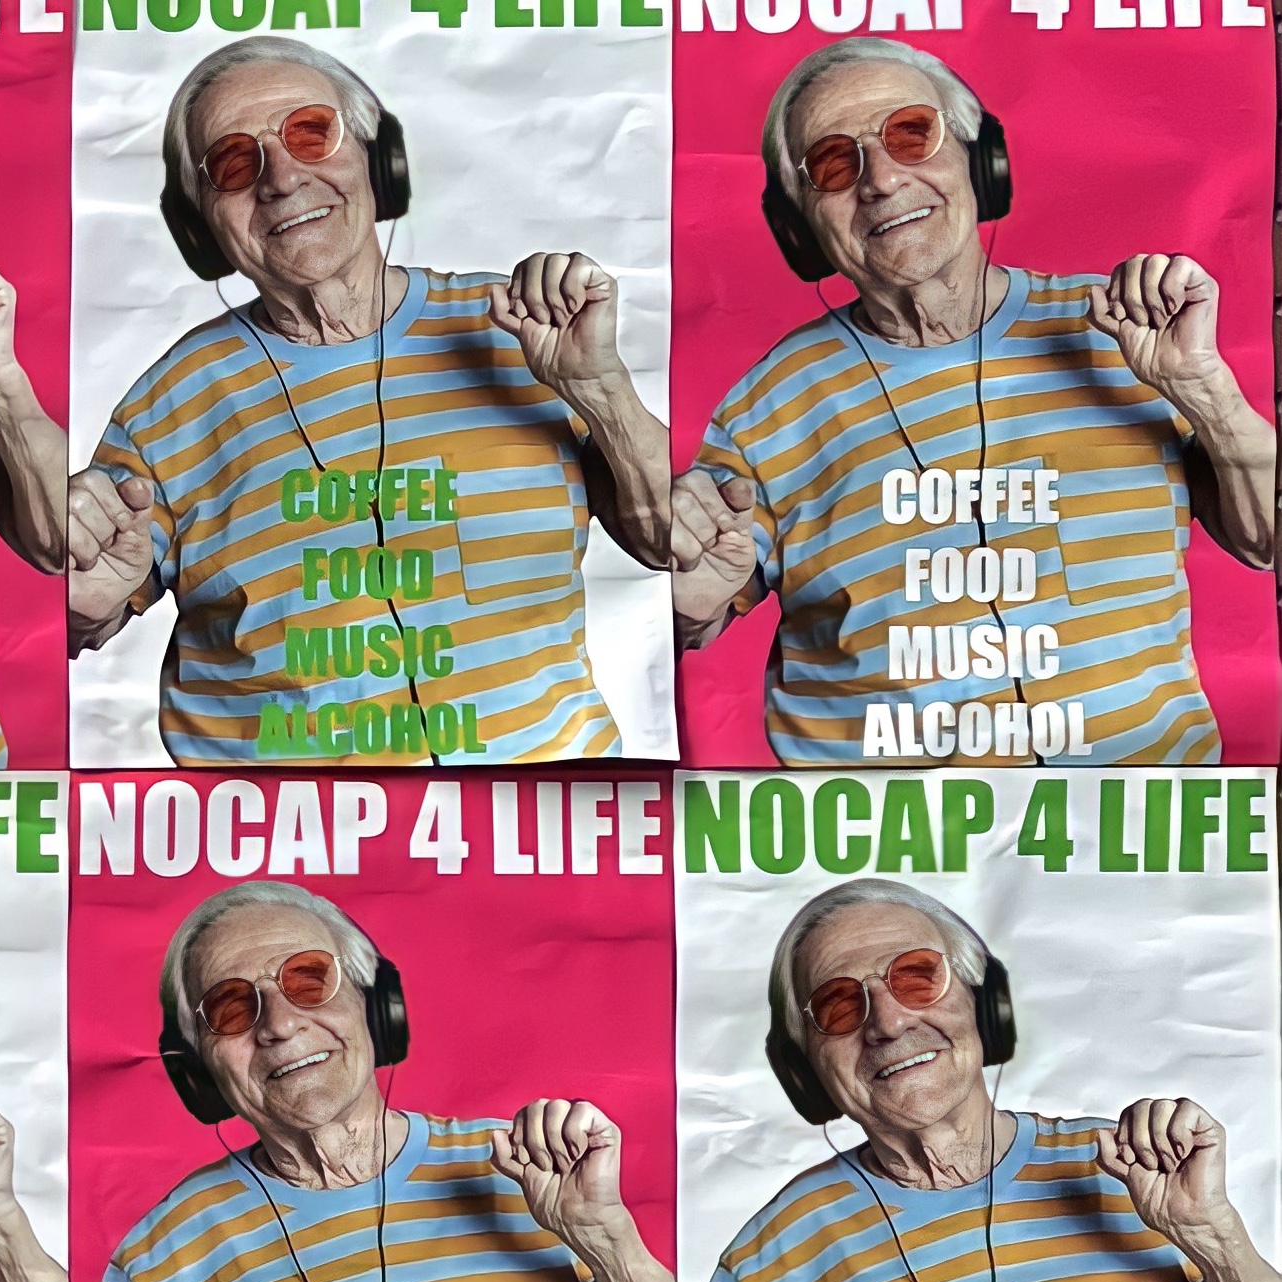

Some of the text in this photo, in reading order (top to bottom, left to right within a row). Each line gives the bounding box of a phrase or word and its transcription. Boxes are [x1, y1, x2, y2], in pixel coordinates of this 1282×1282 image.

[280, 468, 458, 522] COFFEE
[881, 469, 1059, 525] COFFEE
[302, 548, 433, 600] FOOD
[904, 548, 1036, 602] FOOD
[284, 625, 453, 680] MUSIC
[887, 625, 1058, 680] MUSIC
[256, 703, 486, 758] ALCOHOL
[862, 702, 1093, 757] ALCOHOL
[80, 780, 662, 876] NOCAP 4 LIFE
[684, 777, 1267, 874] NOCAP 4 LIFE
